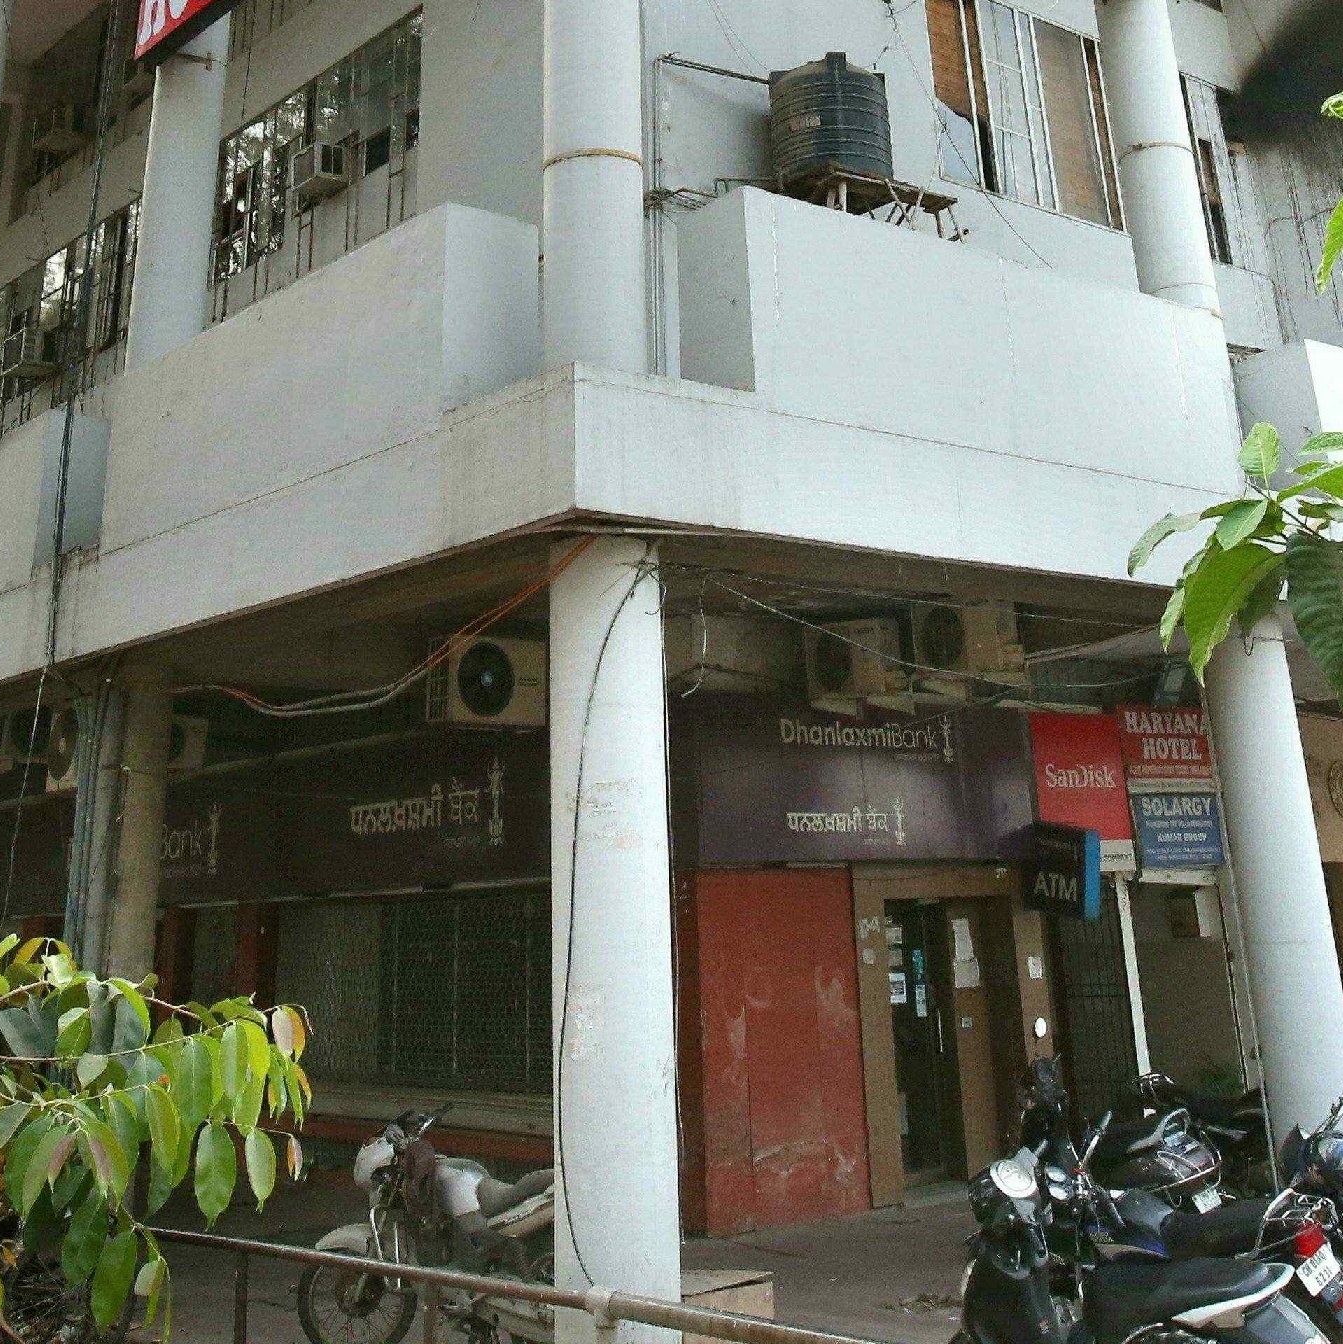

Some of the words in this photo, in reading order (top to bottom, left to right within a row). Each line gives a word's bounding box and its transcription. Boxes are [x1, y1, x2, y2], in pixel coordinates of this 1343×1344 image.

[1125, 711, 1212, 734] HARYANA
[1143, 738, 1202, 760] HOTEL
[1044, 762, 1117, 789] SanDisk
[1142, 797, 1211, 816] SOLARGY
[1033, 871, 1077, 902] ATM
